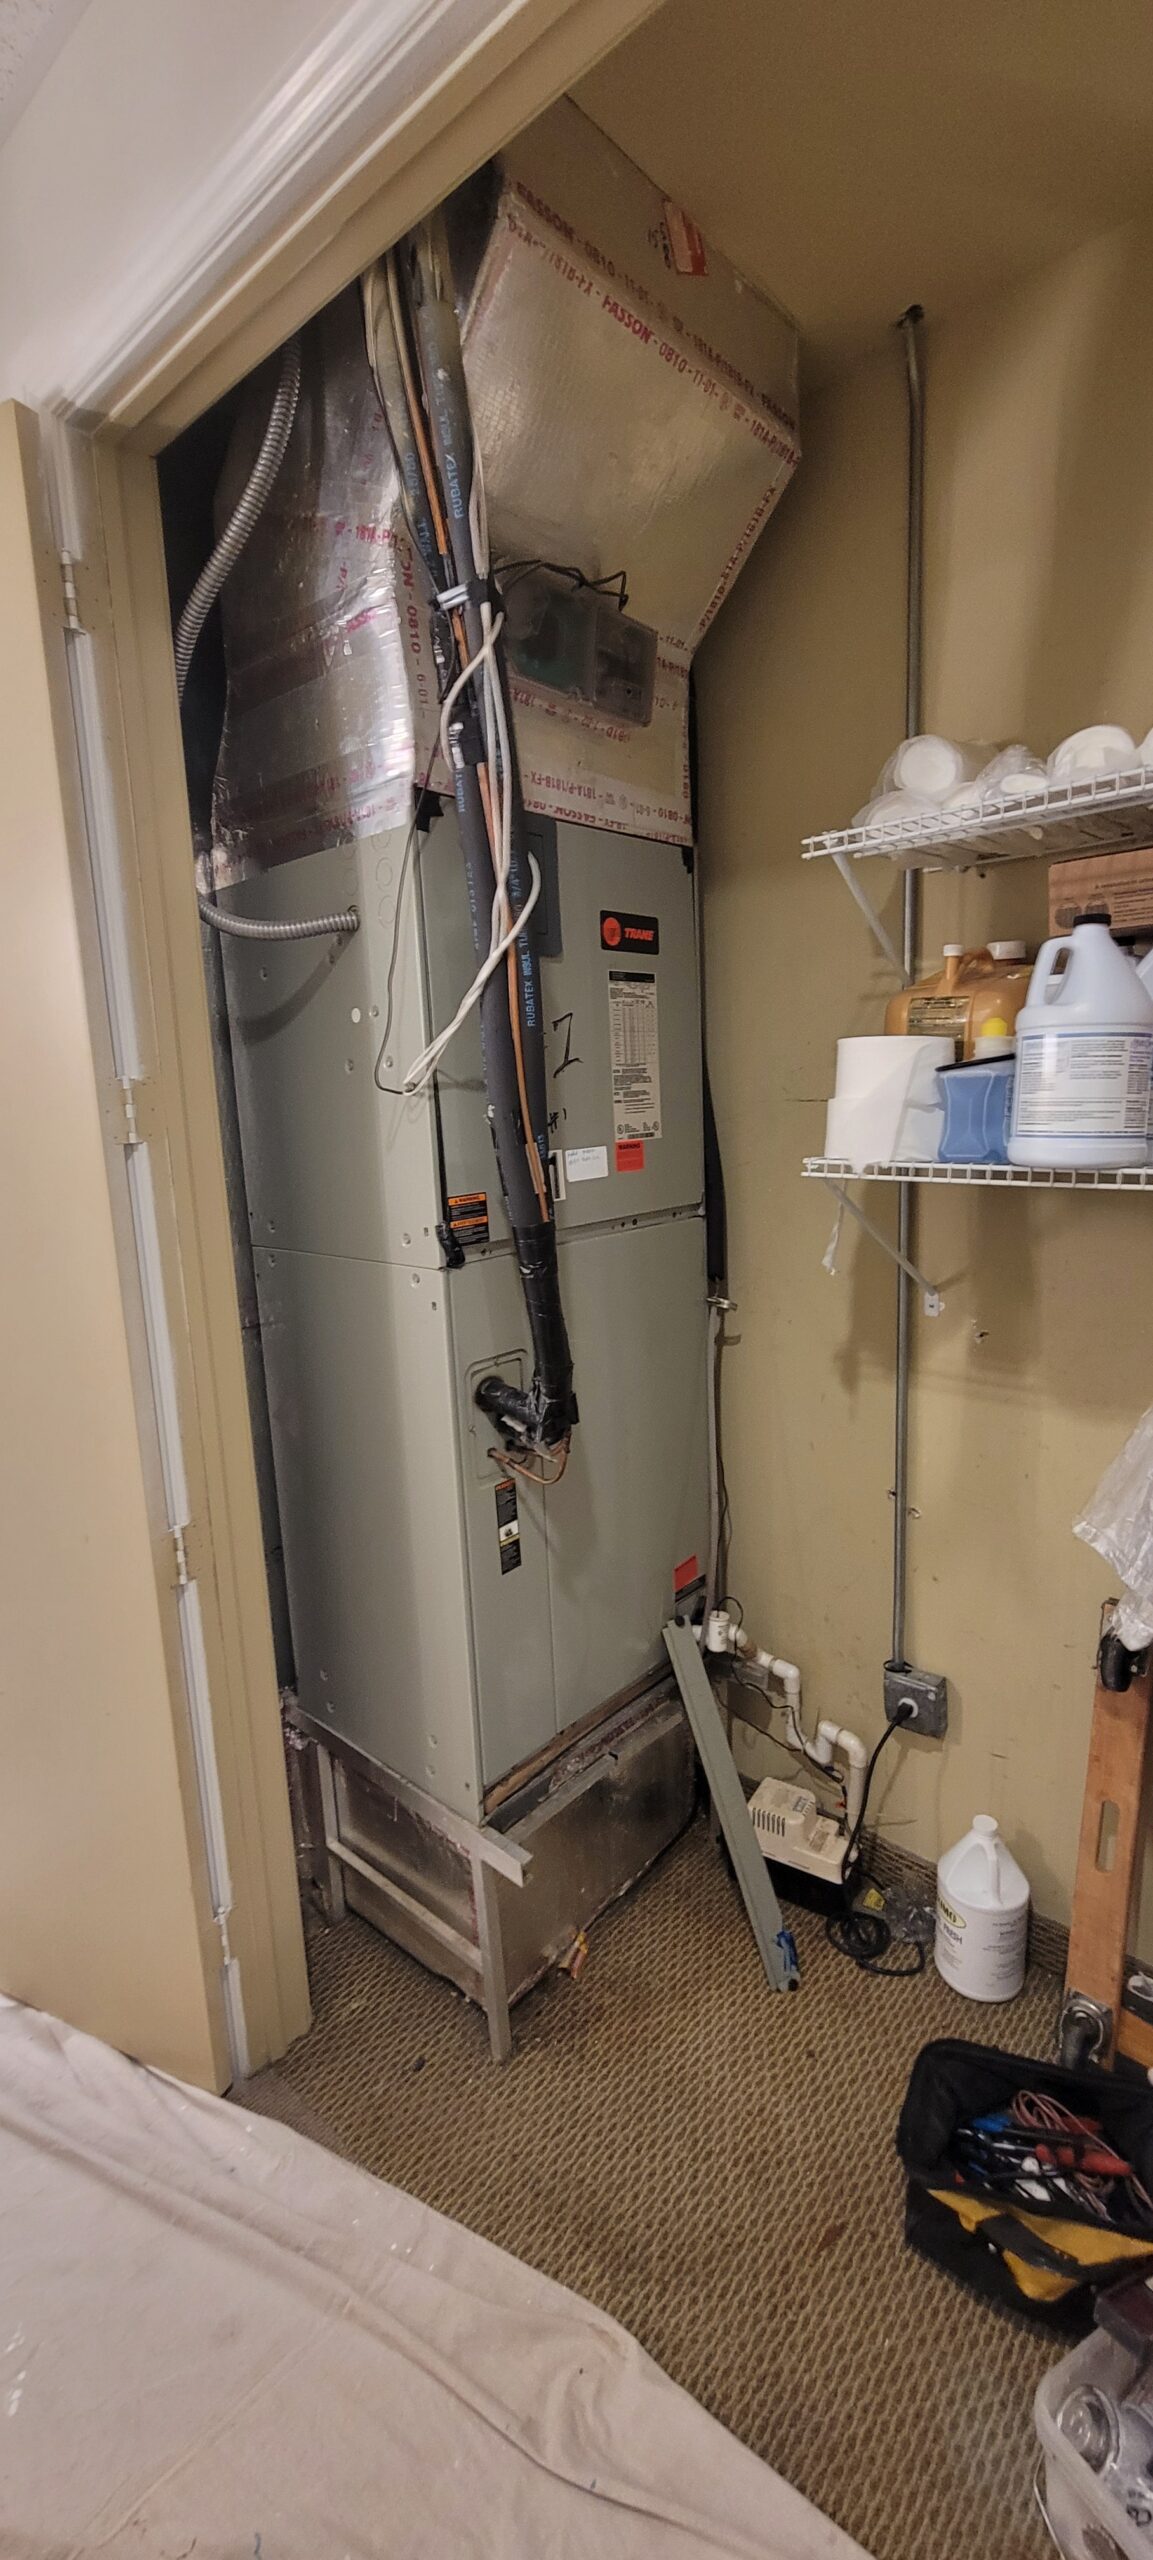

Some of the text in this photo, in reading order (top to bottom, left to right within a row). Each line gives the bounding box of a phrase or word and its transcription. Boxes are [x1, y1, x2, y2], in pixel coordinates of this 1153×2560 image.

[602, 296, 654, 344] FASSON
[658, 342, 687, 373] 0810
[405, 604, 424, 656] 0810
[624, 927, 655, 942] TRANE
[523, 981, 536, 1027] RUBATEX
